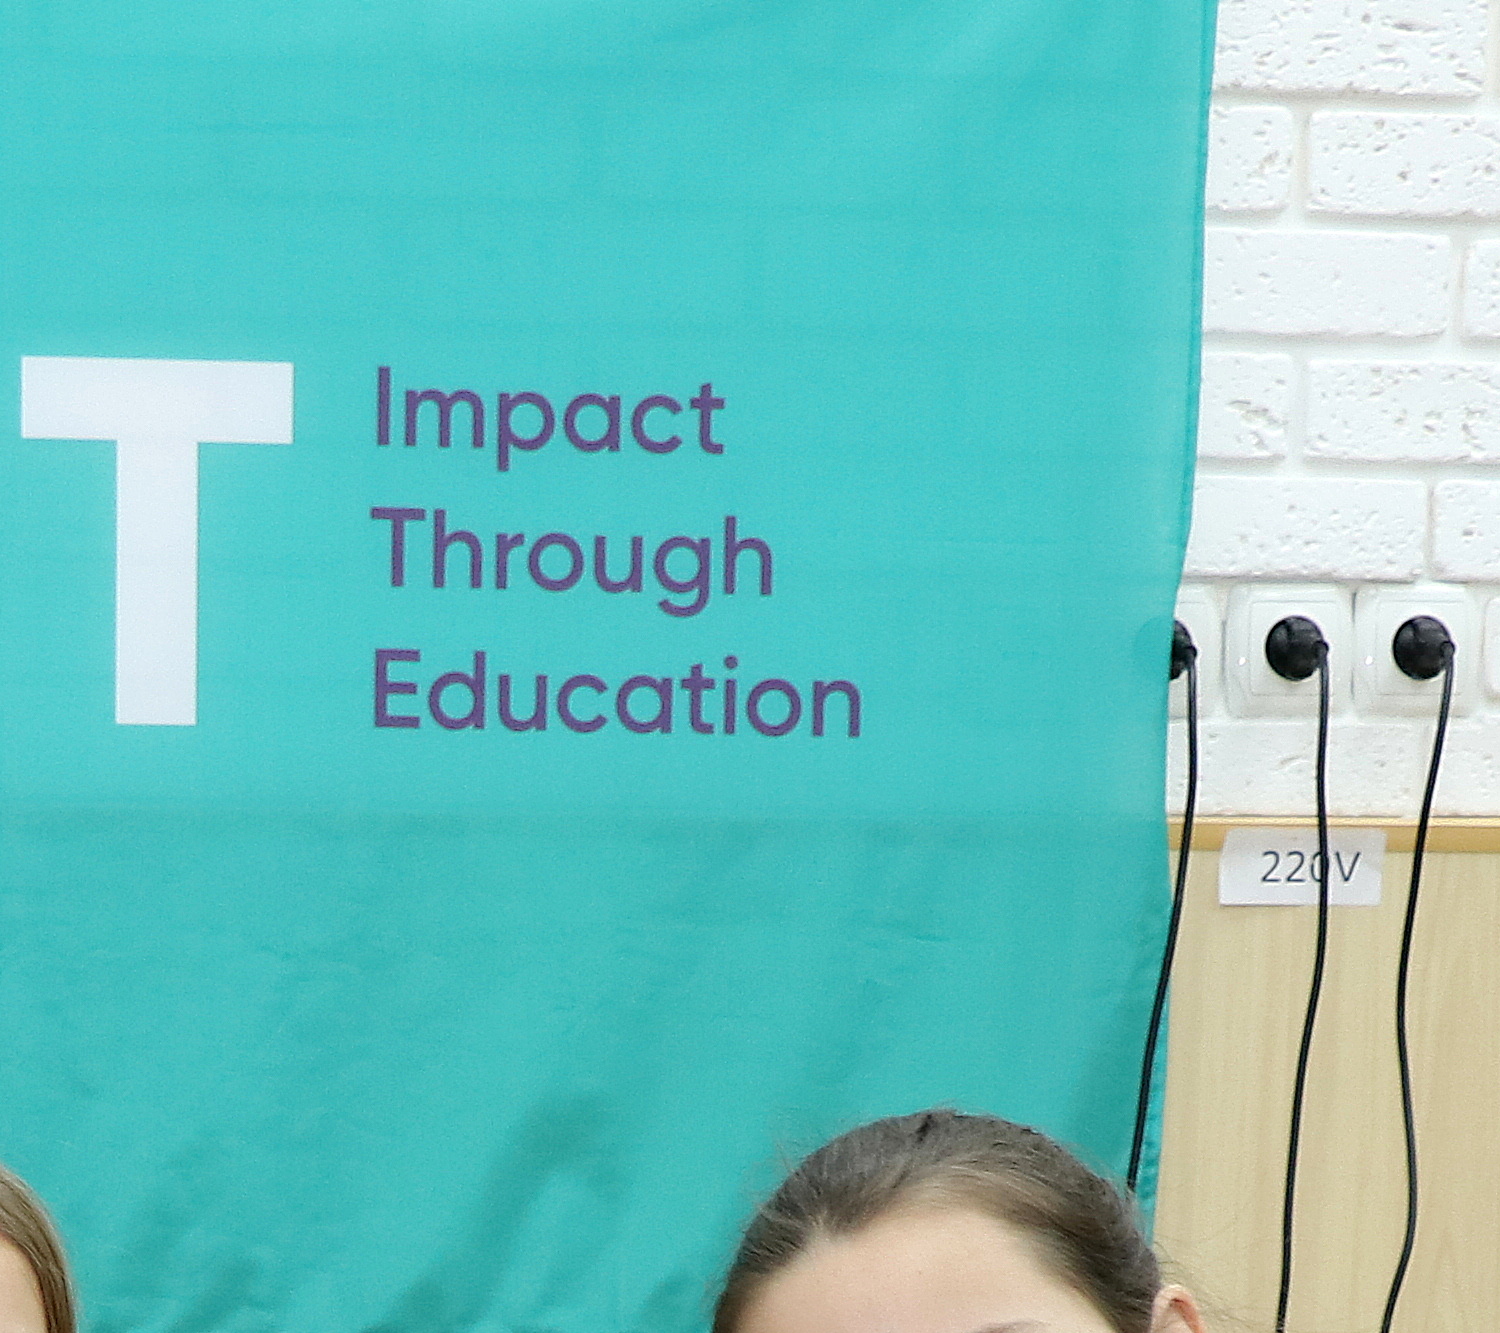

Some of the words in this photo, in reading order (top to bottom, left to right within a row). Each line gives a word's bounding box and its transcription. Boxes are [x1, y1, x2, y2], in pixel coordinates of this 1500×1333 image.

[374, 364, 727, 472] Impact
[371, 507, 776, 619] Through
[372, 648, 865, 738] Education
